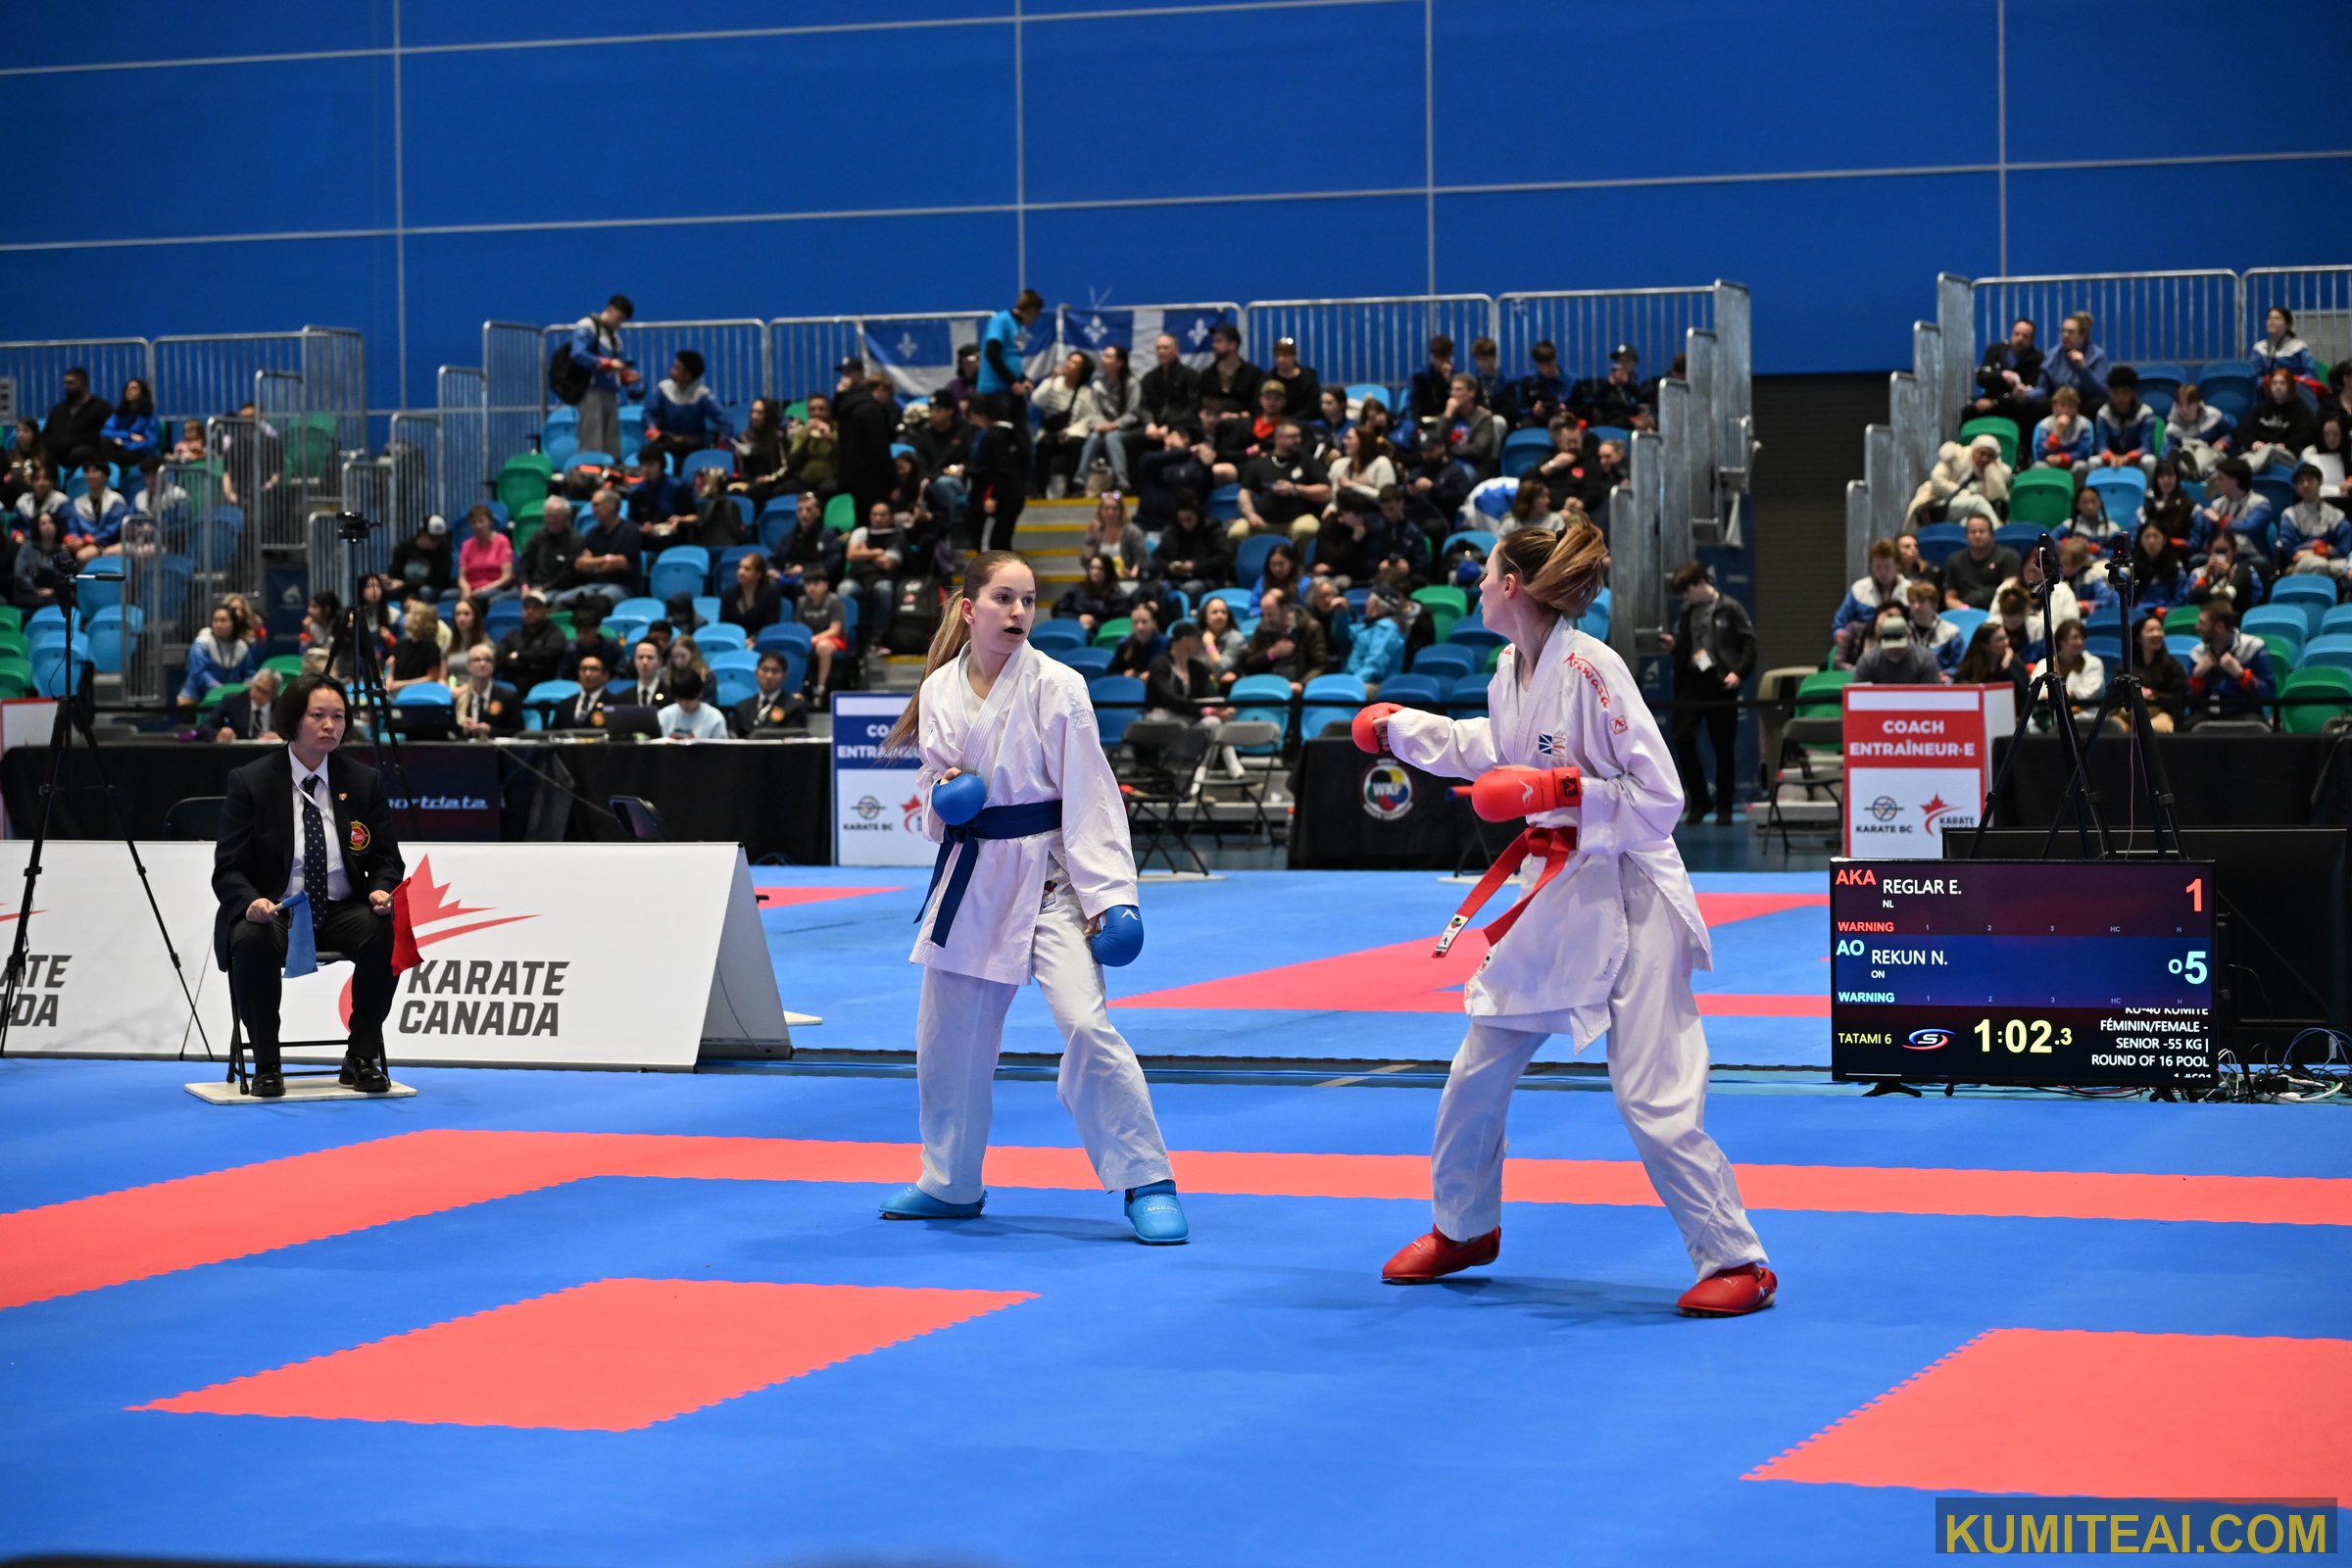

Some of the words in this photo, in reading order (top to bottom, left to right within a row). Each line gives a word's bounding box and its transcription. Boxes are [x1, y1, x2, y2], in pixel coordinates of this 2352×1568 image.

[1883, 720, 1944, 734] COACH
[1939, 815, 1976, 824] KARATE
[1856, 825, 1896, 834] KARATE
[1899, 825, 1913, 834] BC
[1836, 869, 1877, 885] AKA
[1883, 879, 1945, 895] REGLAR
[1949, 880, 1962, 895] E.
[2185, 878, 2203, 912] 1
[1883, 900, 1894, 908] NL
[1838, 921, 1894, 932] WARNING
[1836, 940, 1865, 956] AO
[1871, 950, 1926, 964] REKUN
[1931, 950, 1948, 965] N.
[407, 960, 570, 996] KARATE
[1838, 992, 1895, 1003] WARNING
[399, 1000, 559, 1036] CANADA
[2100, 1017, 2200, 1033] FÉMININ/FEMALE
[1838, 1033, 1882, 1045] TATAMI
[1885, 1033, 1891, 1045] 6
[2116, 1037, 2160, 1049] SENIOR
[2163, 1039, 2182, 1050] -55
[2185, 1039, 2202, 1050] KG
[2091, 1054, 2136, 1066] ROUND
[2138, 1054, 2155, 1066] OF
[2159, 1055, 2173, 1067] 16
[2176, 1056, 2209, 1067] POOL
